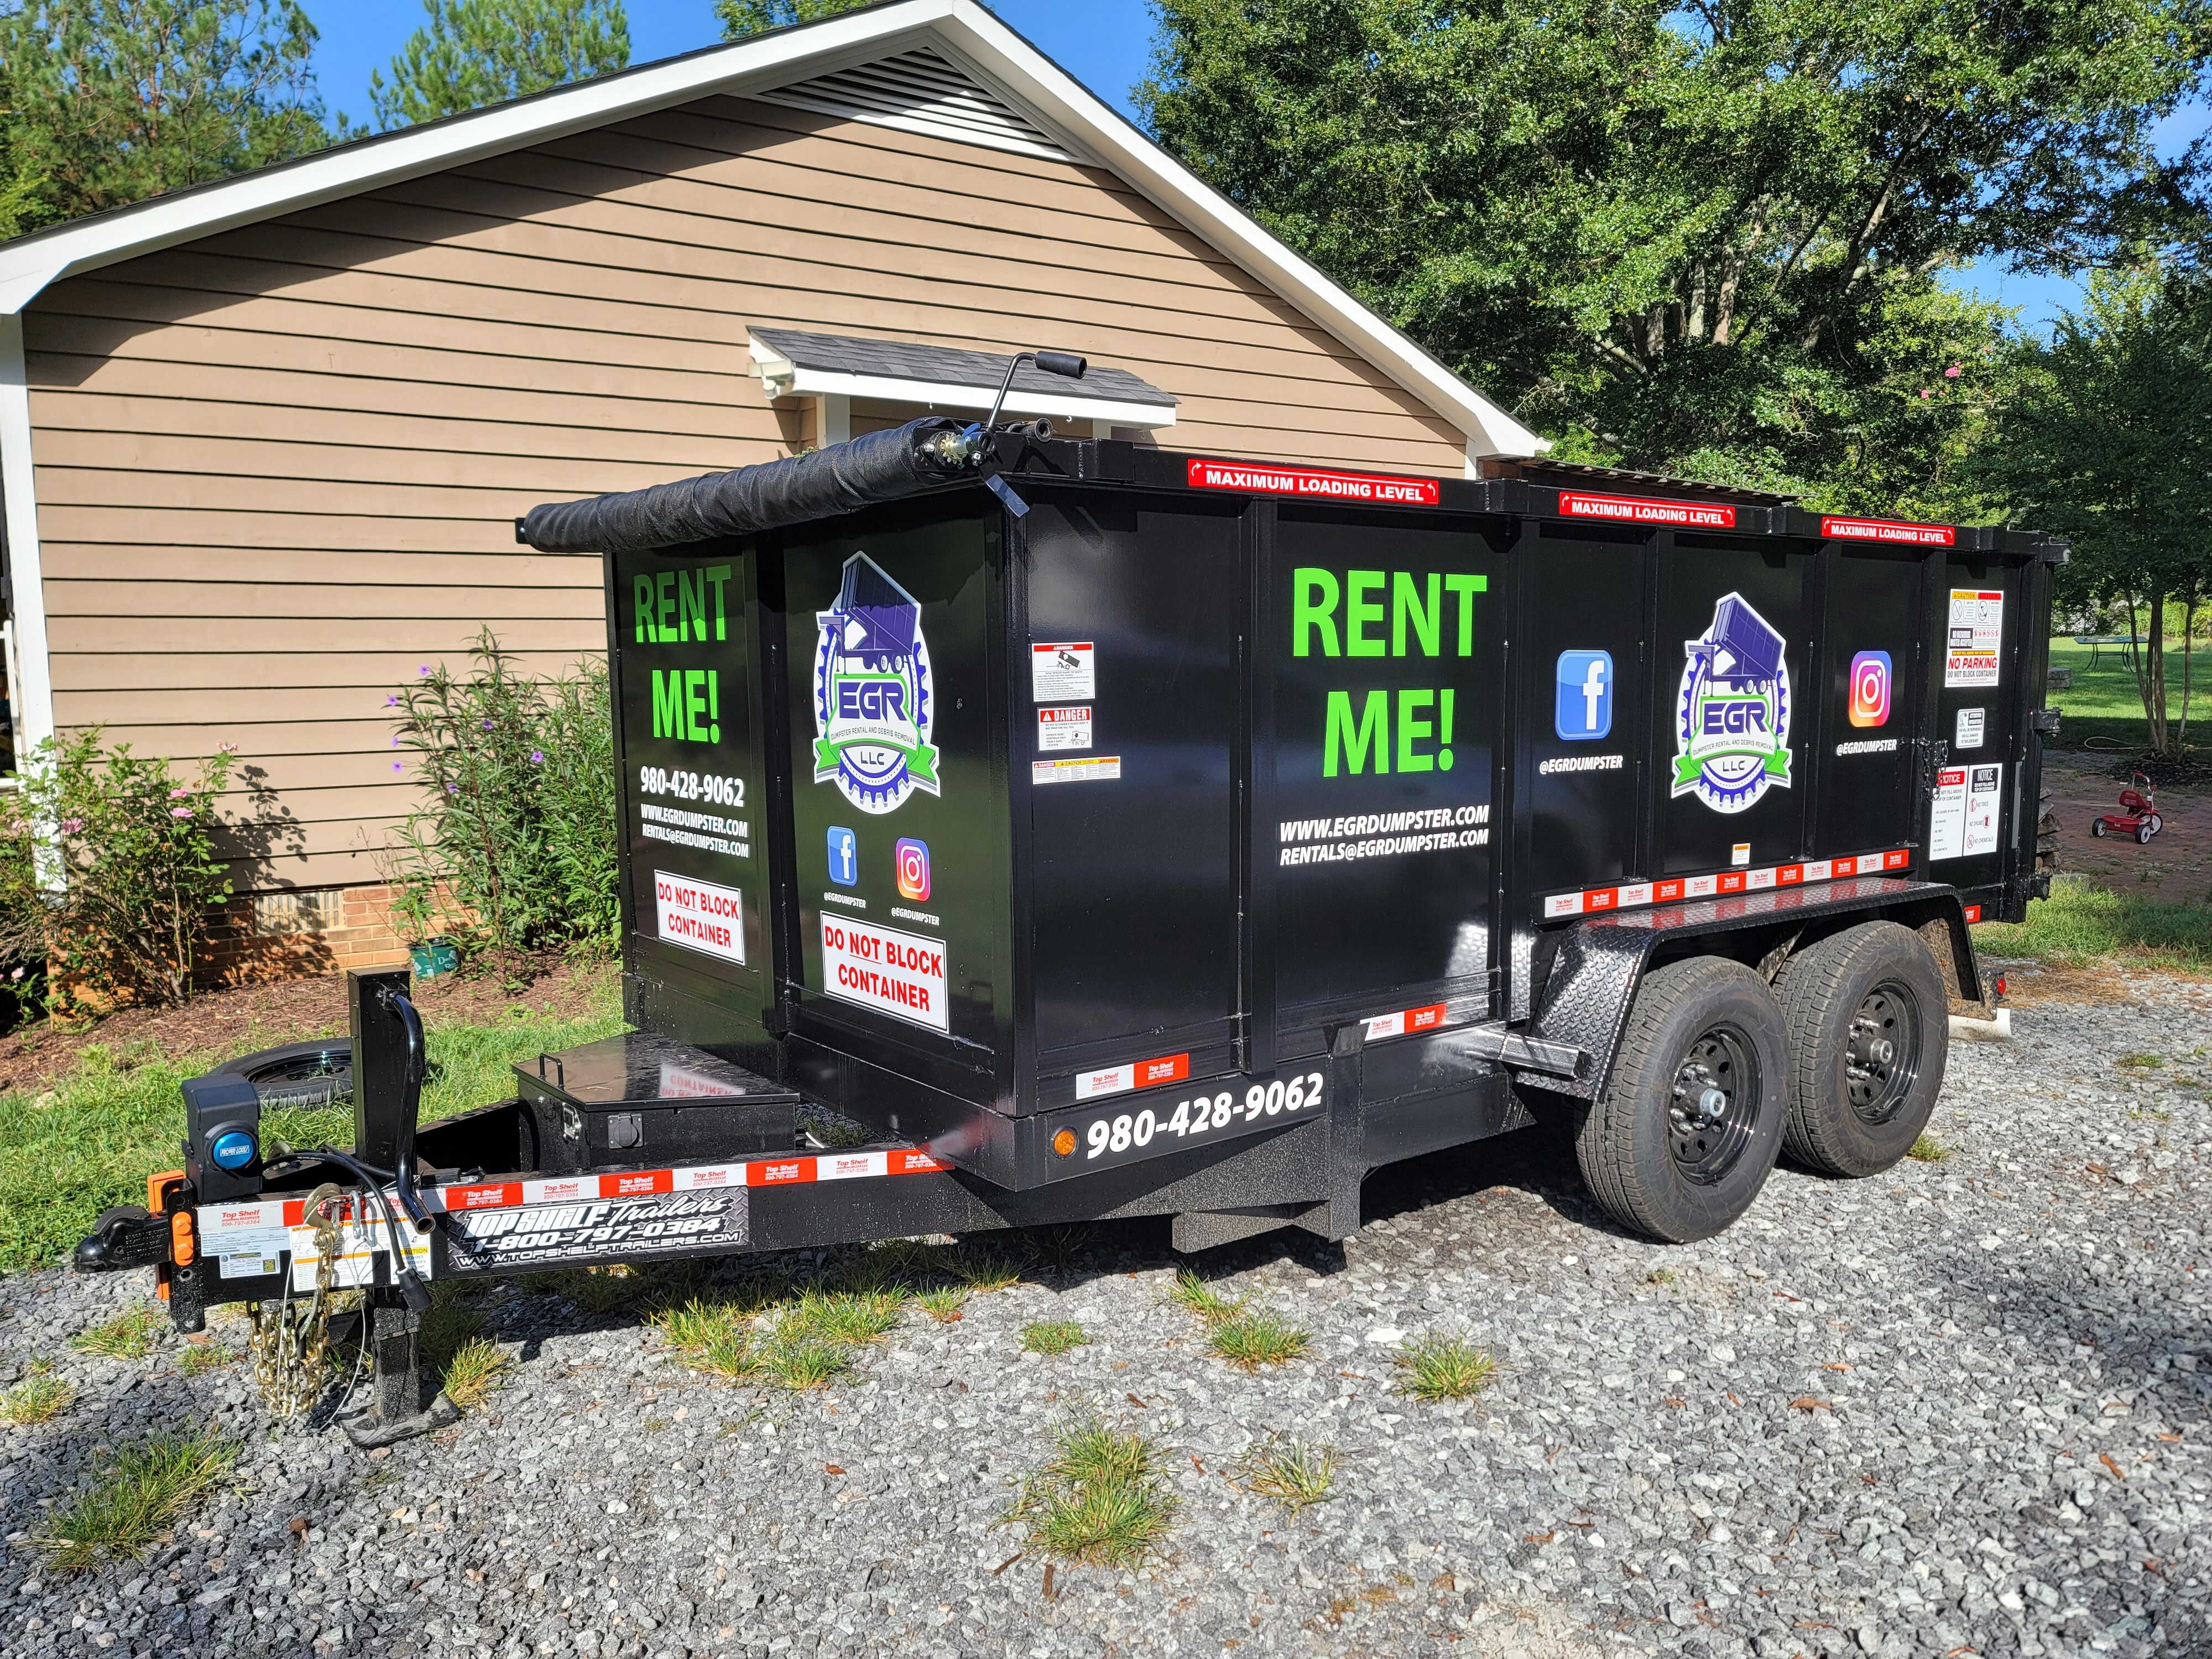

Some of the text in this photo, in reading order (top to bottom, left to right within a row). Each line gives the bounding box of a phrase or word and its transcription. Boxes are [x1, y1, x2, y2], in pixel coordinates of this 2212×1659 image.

[1206, 471, 1425, 501] MAXIMUM LOADING LEVEL
[1572, 502, 1724, 524] MAXIMUM LOADING LEVEL
[1831, 525, 1946, 542] MAXIMUM LOADING LEVEL
[633, 565, 731, 643] RENT
[1293, 567, 1488, 656] RENT
[1948, 657, 1997, 669] NO PARKING
[652, 670, 720, 744] ME!
[838, 682, 907, 723] EGR
[1054, 709, 1087, 722] DANGER
[1703, 702, 1767, 735] EGR
[831, 728, 852, 740] DUMPSTER
[852, 726, 868, 734] RENTAL
[878, 728, 894, 737] DEBRIS
[894, 732, 916, 745] REMOVAL
[1323, 688, 1454, 777] ME!
[1693, 743, 1715, 755] DUMPSTER
[1755, 741, 1773, 751] REMOVAL
[1836, 739, 1897, 756] @EGRDUMPSTER
[860, 751, 885, 765] LLC
[1539, 755, 1623, 774] @EGRDUMPSTER
[1722, 760, 1745, 772] LLC
[1978, 769, 1994, 781] NOTICE
[640, 765, 744, 807] 980-428-9062
[640, 803, 748, 838] WWW.EGRDUMPSTER.COM
[1280, 805, 1490, 842] WWW.EGRDUMPSTER.COM
[642, 823, 749, 858] RENTALS@EGRDUMPSTER.COM
[1280, 828, 1489, 866] RENTALS@EGRDUMPSTER.COM
[658, 882, 739, 920] DO NOT BLOCK
[824, 891, 867, 909] @EGRDUMPSTER
[891, 907, 940, 926] @EGRDUMPSTER
[668, 913, 732, 948] CONTAINER
[825, 925, 942, 978] DO NOT BLOCK
[838, 963, 930, 1012] CONTAINER
[1104, 1072, 1119, 1081] Shelf
[1159, 1061, 1174, 1070] Shelf
[1087, 1072, 1324, 1160] 980-428-9062
[463, 1194, 733, 1239] TOPSHELF Trailers
[473, 1217, 721, 1253] 1-800-797-0384
